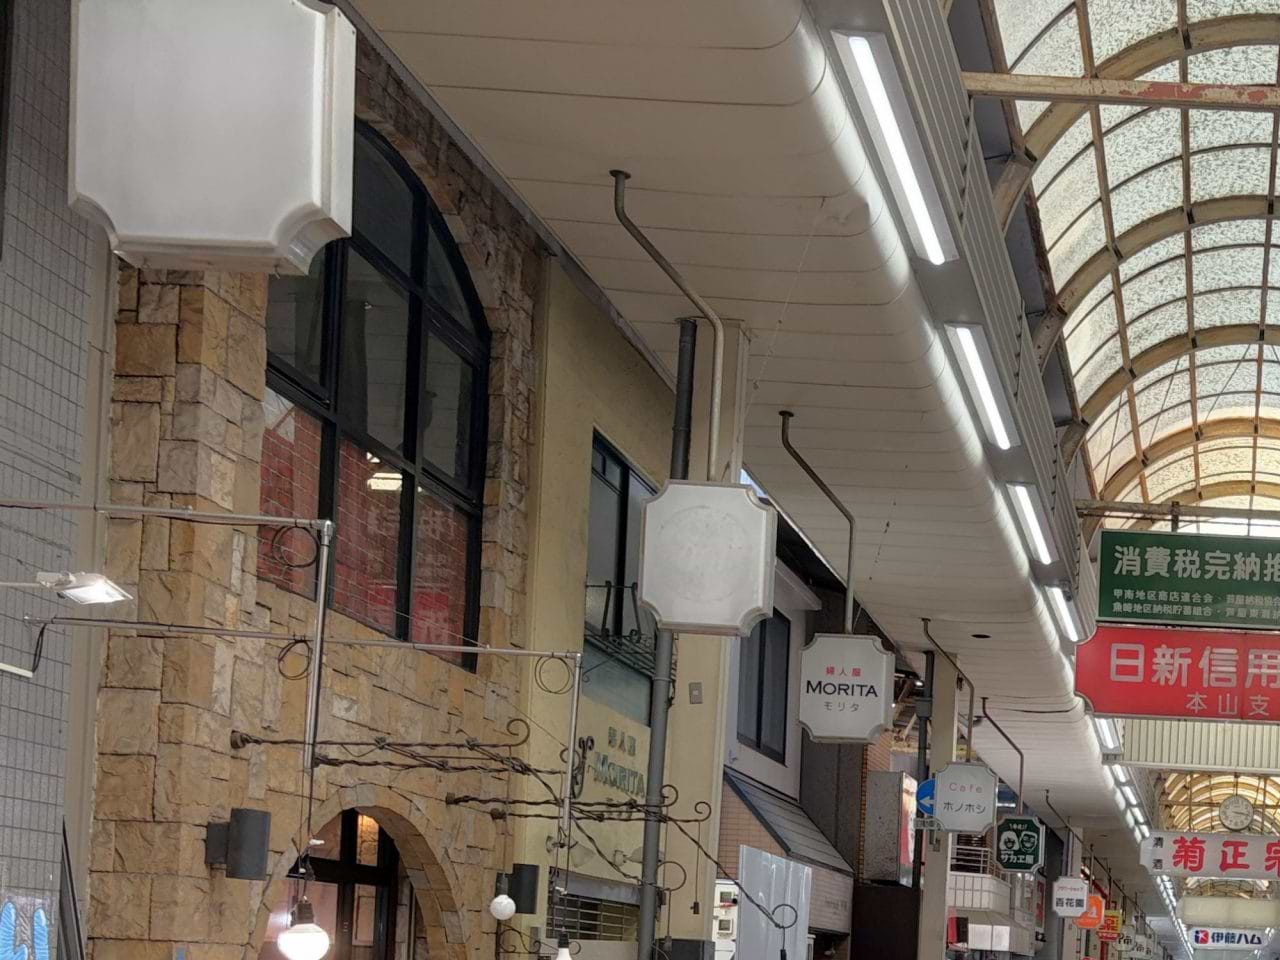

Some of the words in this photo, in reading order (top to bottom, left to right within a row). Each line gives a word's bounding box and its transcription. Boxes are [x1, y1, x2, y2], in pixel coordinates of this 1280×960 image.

[826, 666, 861, 677] 婦人服
[805, 680, 878, 697] MORITA
[823, 701, 860, 712] モリタ
[949, 782, 983, 794] Cafe
[943, 801, 987, 815] ホノホシ
[1055, 898, 1084, 908] 百花園
[1211, 931, 1262, 945] 伊藤ハム
